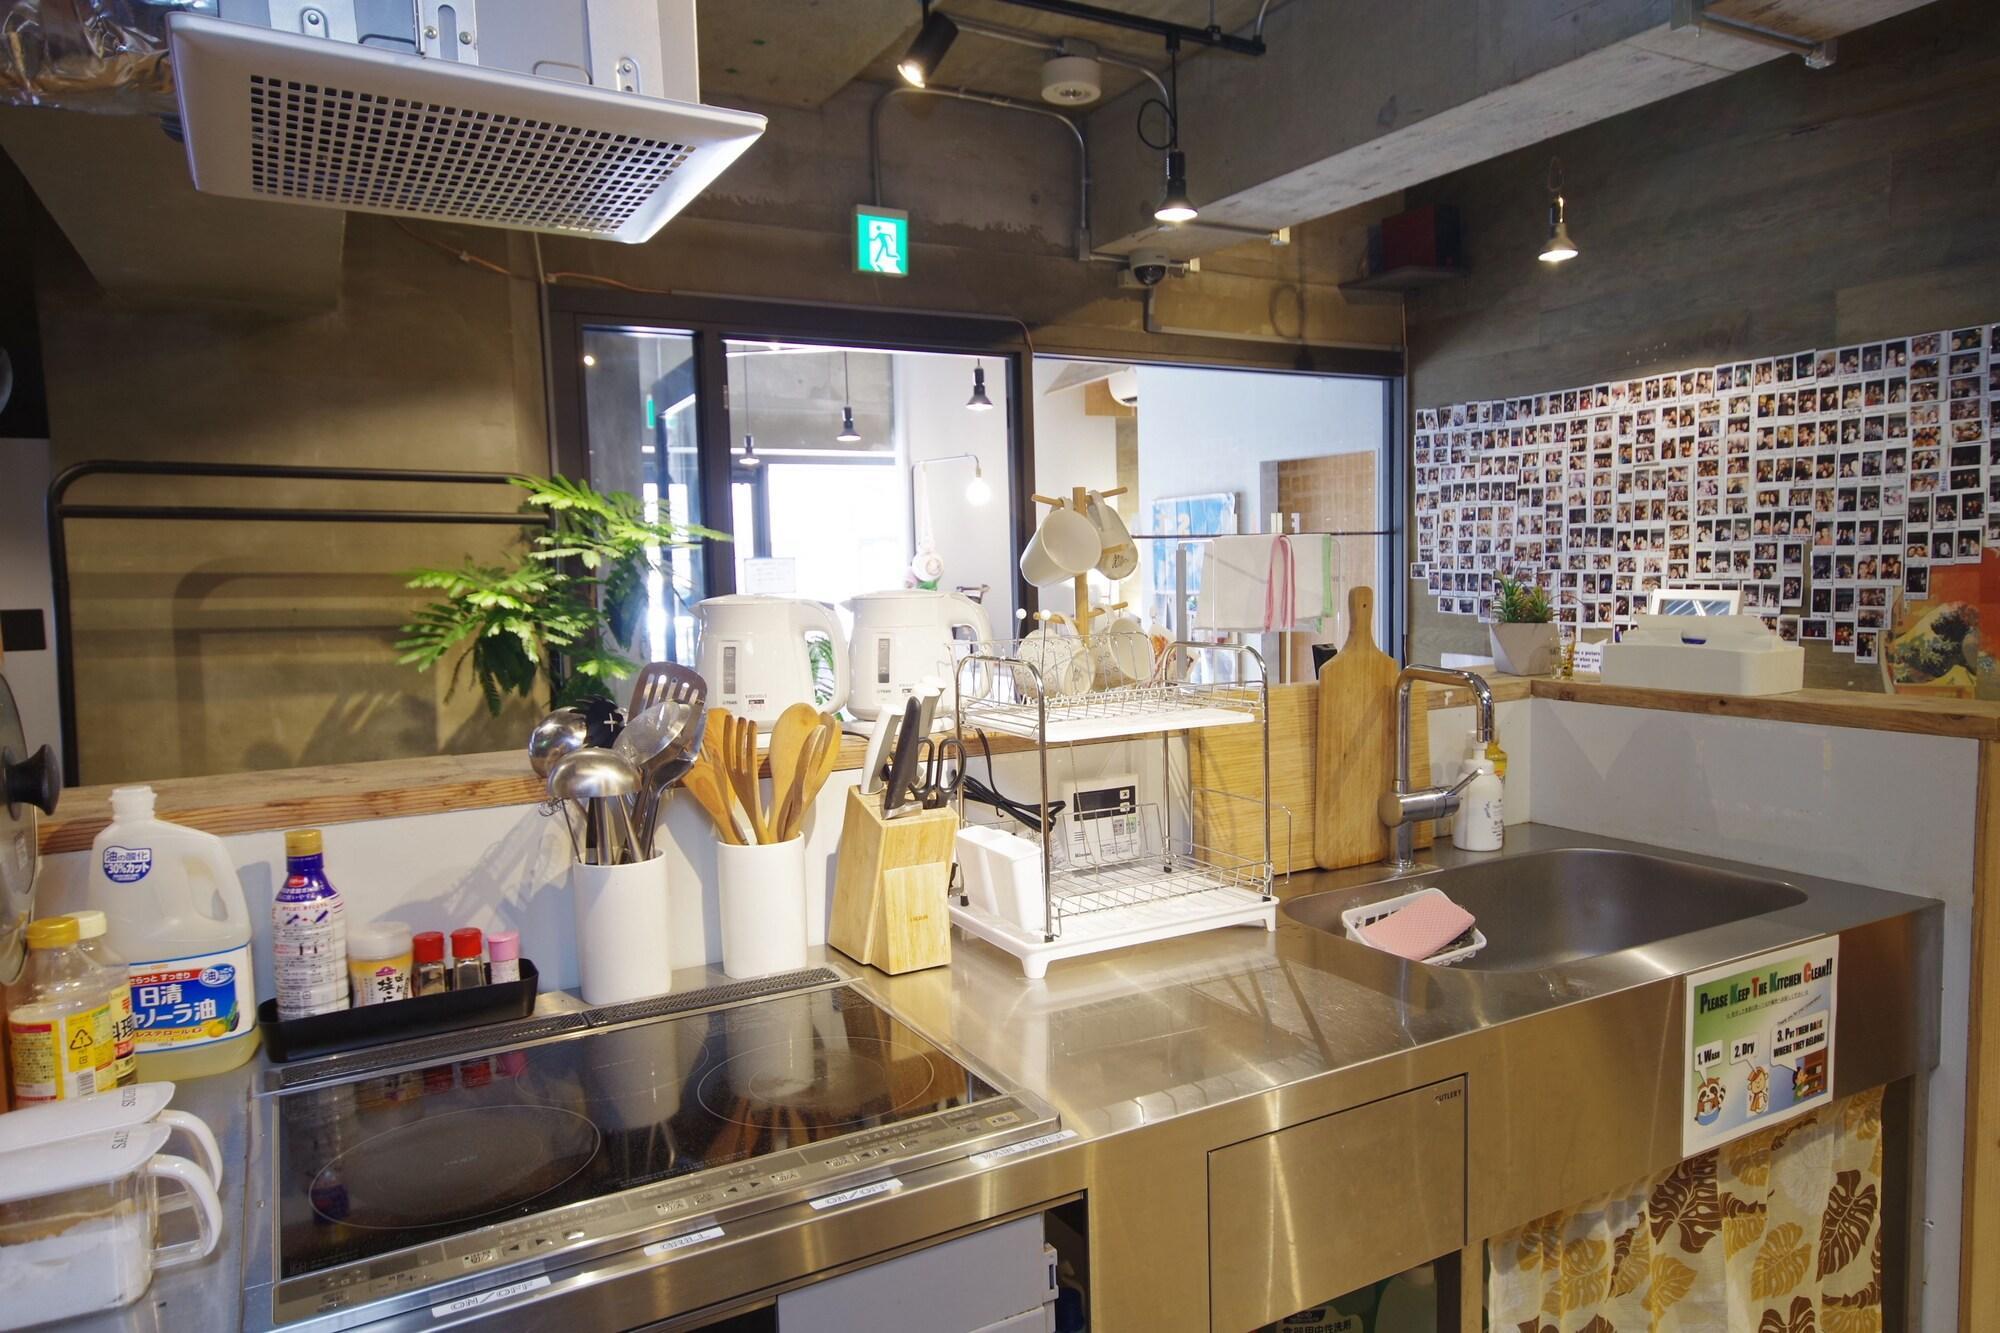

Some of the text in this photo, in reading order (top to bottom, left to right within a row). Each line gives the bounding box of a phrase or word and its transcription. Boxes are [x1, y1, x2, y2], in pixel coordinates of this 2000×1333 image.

[139, 984, 182, 1007] 日清
[1730, 984, 1750, 1005] KEEP
[1752, 976, 1767, 998] THE
[1769, 971, 1802, 993] KITCHEN
[131, 998, 217, 1029] ャノーラ油
[133, 1028, 190, 1038] レステロール
[1777, 1030, 1784, 1042] 3.
[1734, 1045, 1741, 1057] 2.
[1773, 1044, 1792, 1058] WHERE
[1792, 1040, 1805, 1052] THEY
[825, 1182, 889, 1205] ON/OFF
[450, 1281, 534, 1311] ON/OFF
